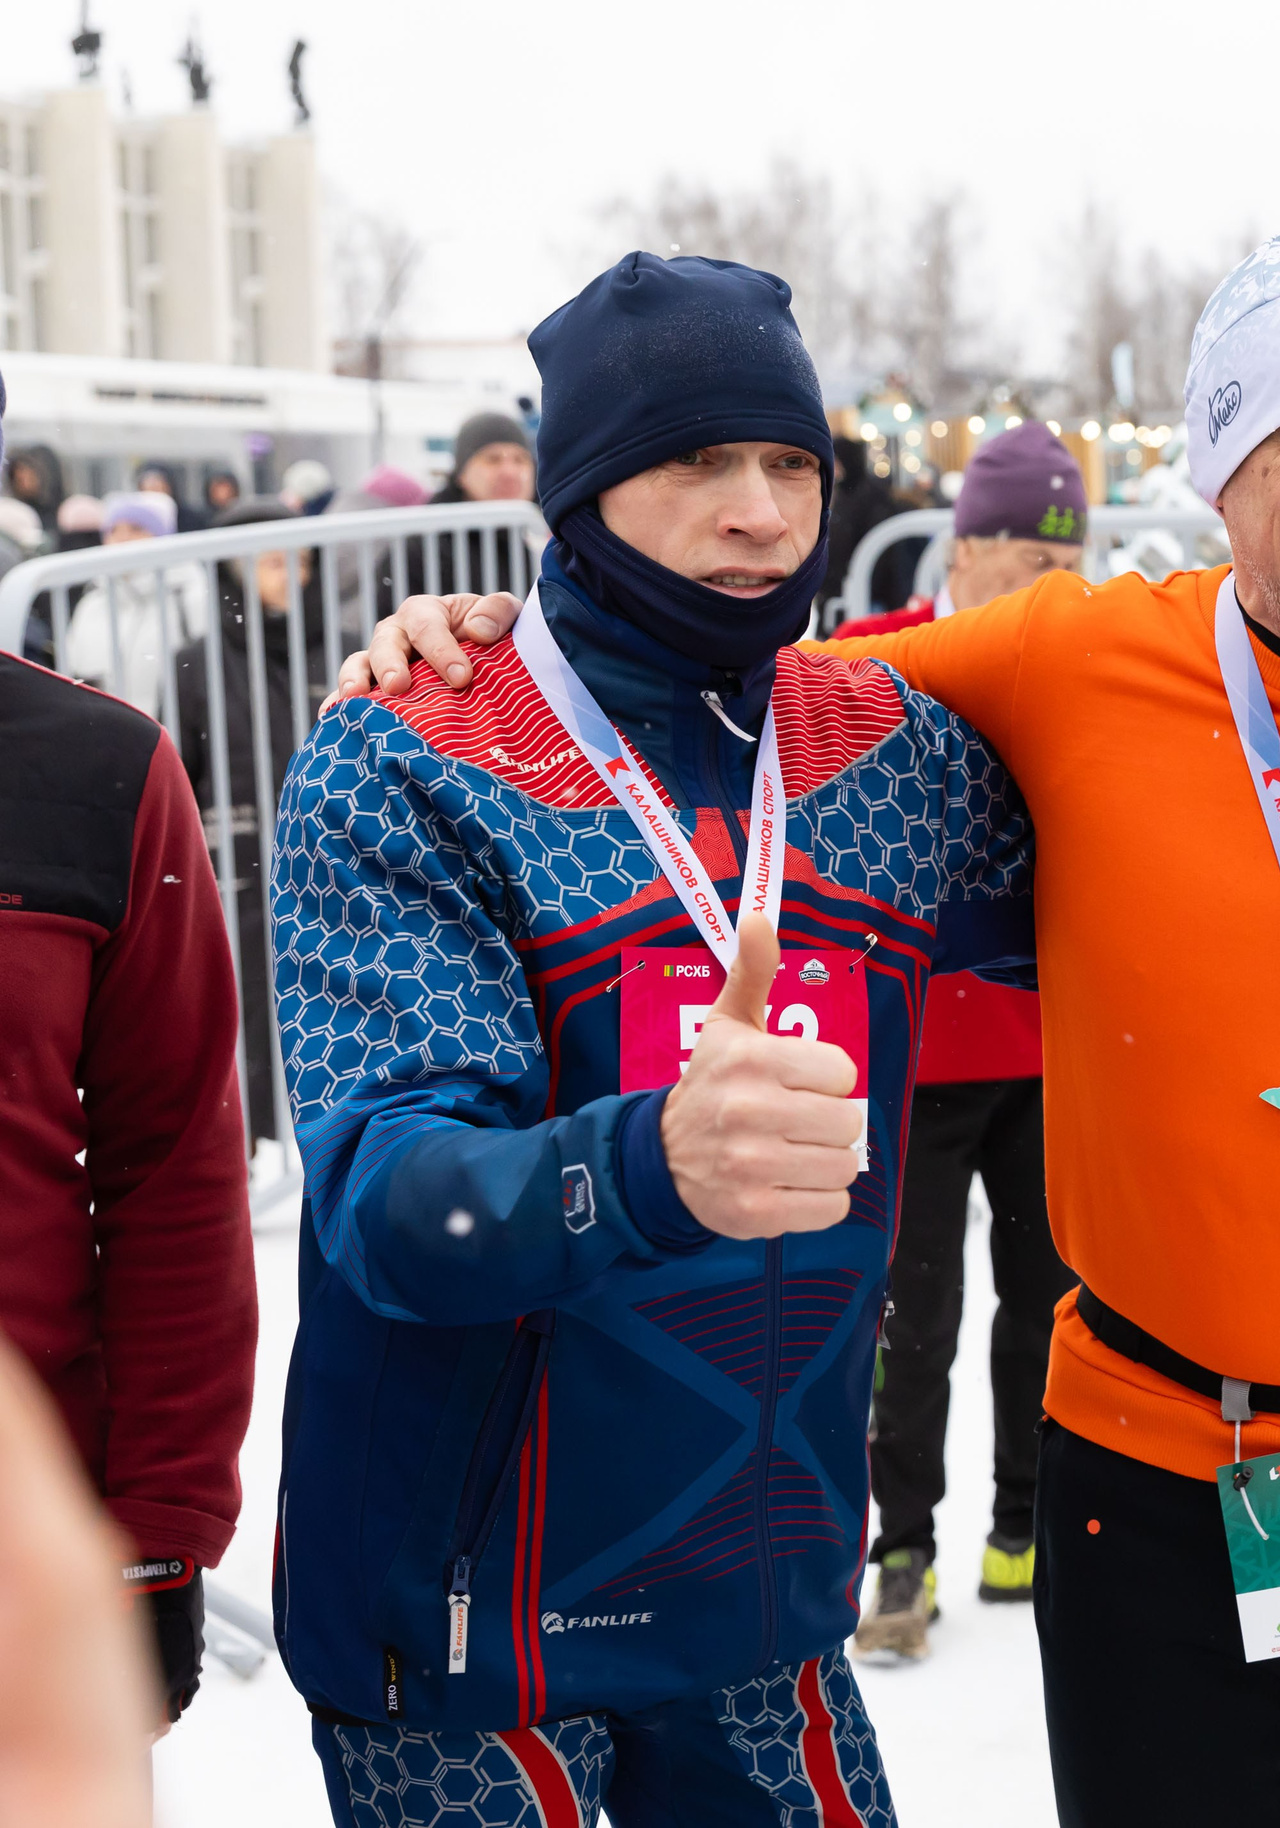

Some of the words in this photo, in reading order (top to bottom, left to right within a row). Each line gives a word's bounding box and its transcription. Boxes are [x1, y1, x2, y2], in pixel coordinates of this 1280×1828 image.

[763, 771, 773, 816] СПОРТ
[625, 782, 698, 888] КАЛАШНИКОВ
[694, 892, 727, 944] СПОРТ
[676, 965, 710, 978] РСХБ
[122, 1563, 168, 1580] TEMPESTA
[567, 1612, 654, 1629] FANLIFE
[388, 1685, 398, 1711] ZERO
